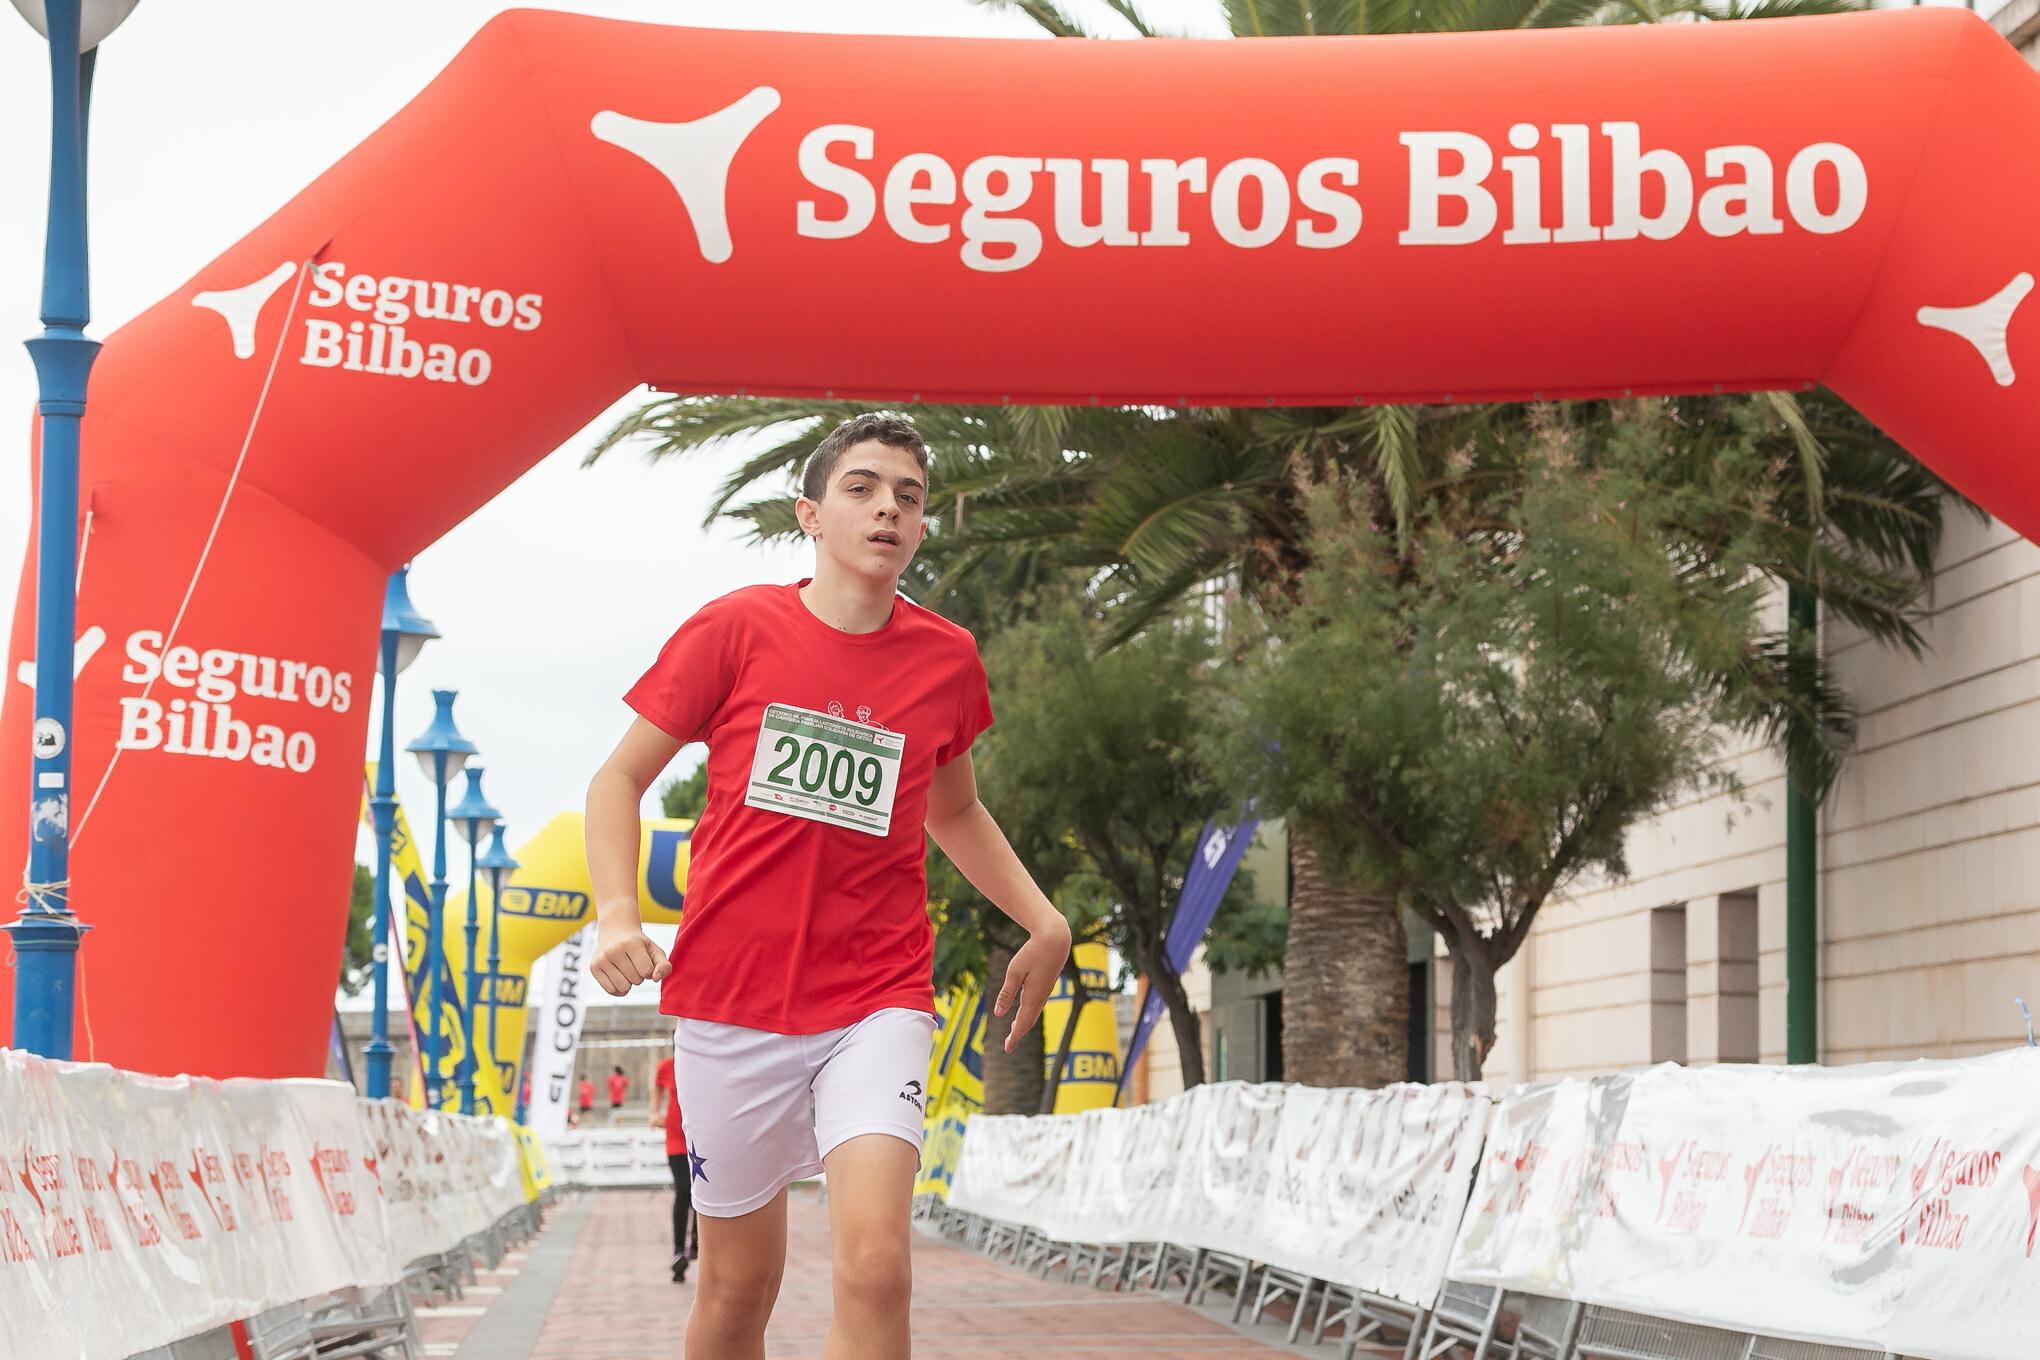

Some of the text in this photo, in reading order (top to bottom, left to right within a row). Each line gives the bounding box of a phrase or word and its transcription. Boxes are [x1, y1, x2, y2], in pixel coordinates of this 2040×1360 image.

[797, 121, 1869, 273] Seguros Bilbao
[307, 261, 543, 332] Seguros
[299, 318, 492, 386] Bilbao
[122, 630, 352, 713] Seguros
[115, 697, 316, 773] Bilbao
[767, 735, 883, 806] 2009
[534, 891, 585, 917] BM
[1074, 1054, 1114, 1080] BM
